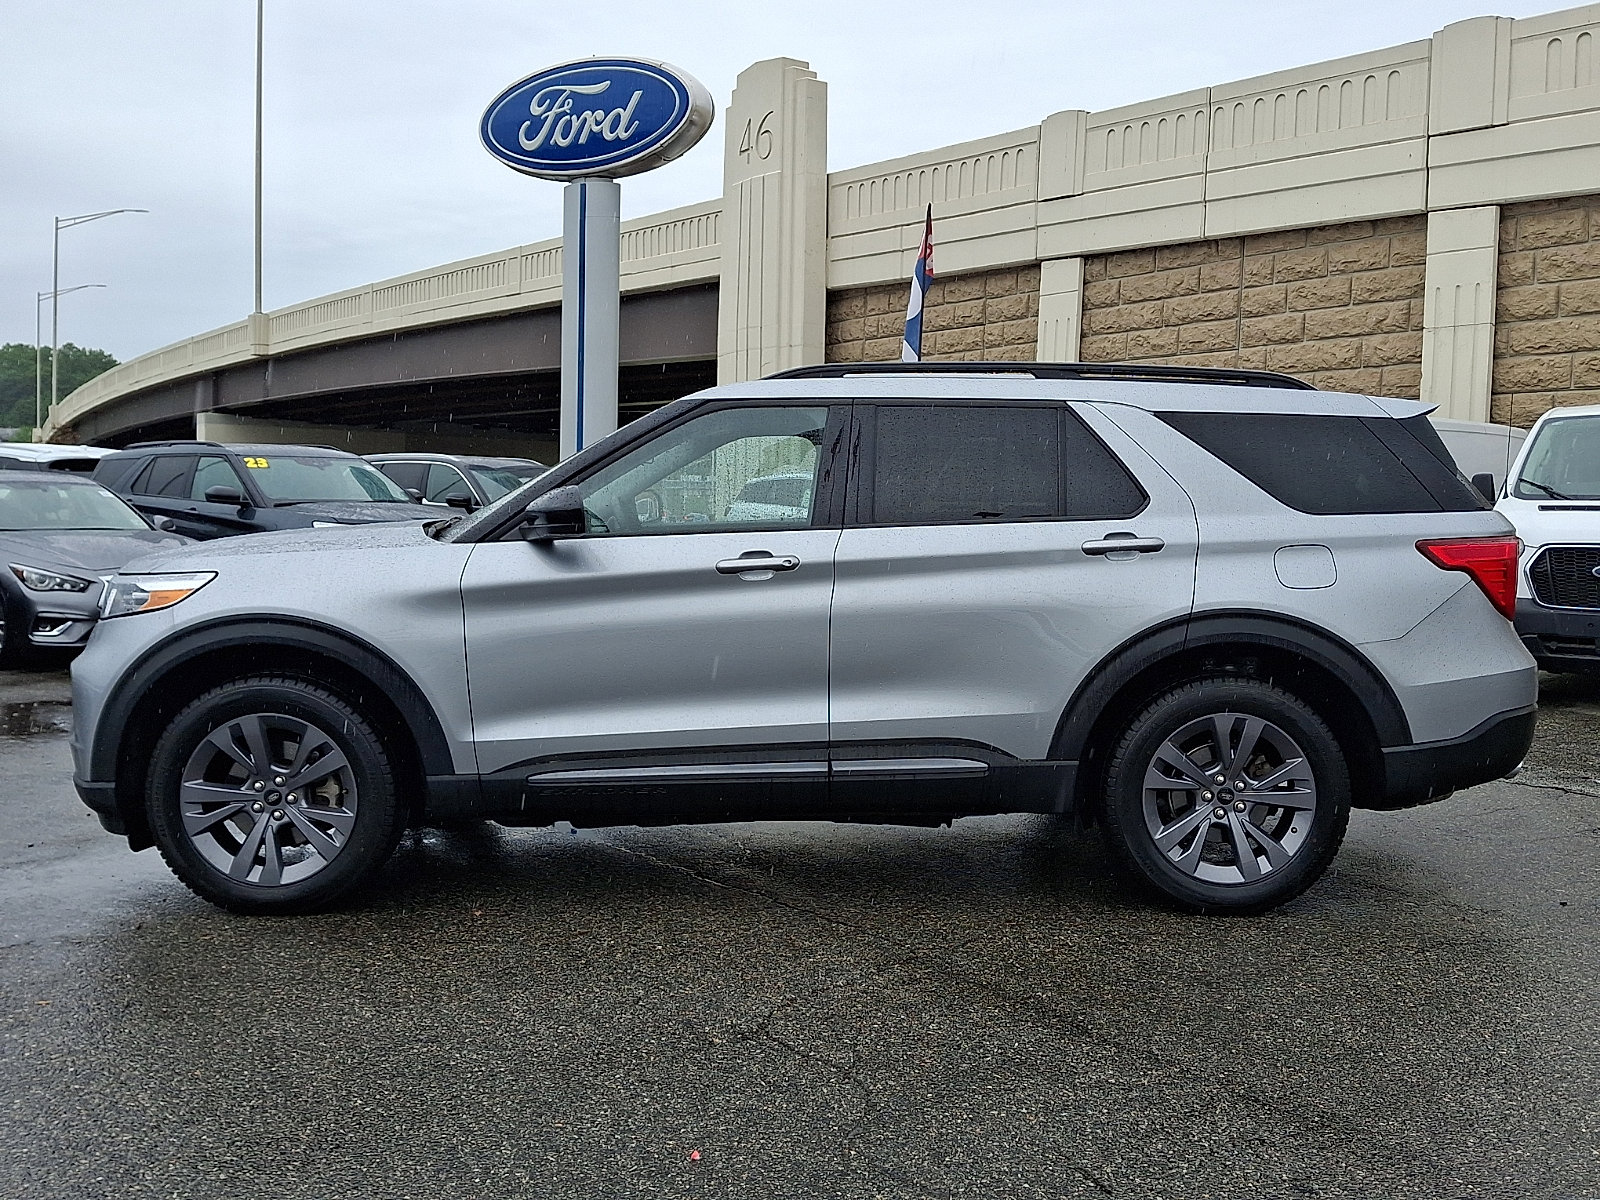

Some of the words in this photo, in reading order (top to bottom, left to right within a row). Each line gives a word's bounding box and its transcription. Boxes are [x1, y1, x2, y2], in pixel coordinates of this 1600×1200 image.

[518, 80, 643, 151] Ford
[738, 110, 775, 165] 46
[242, 457, 269, 469] 23
